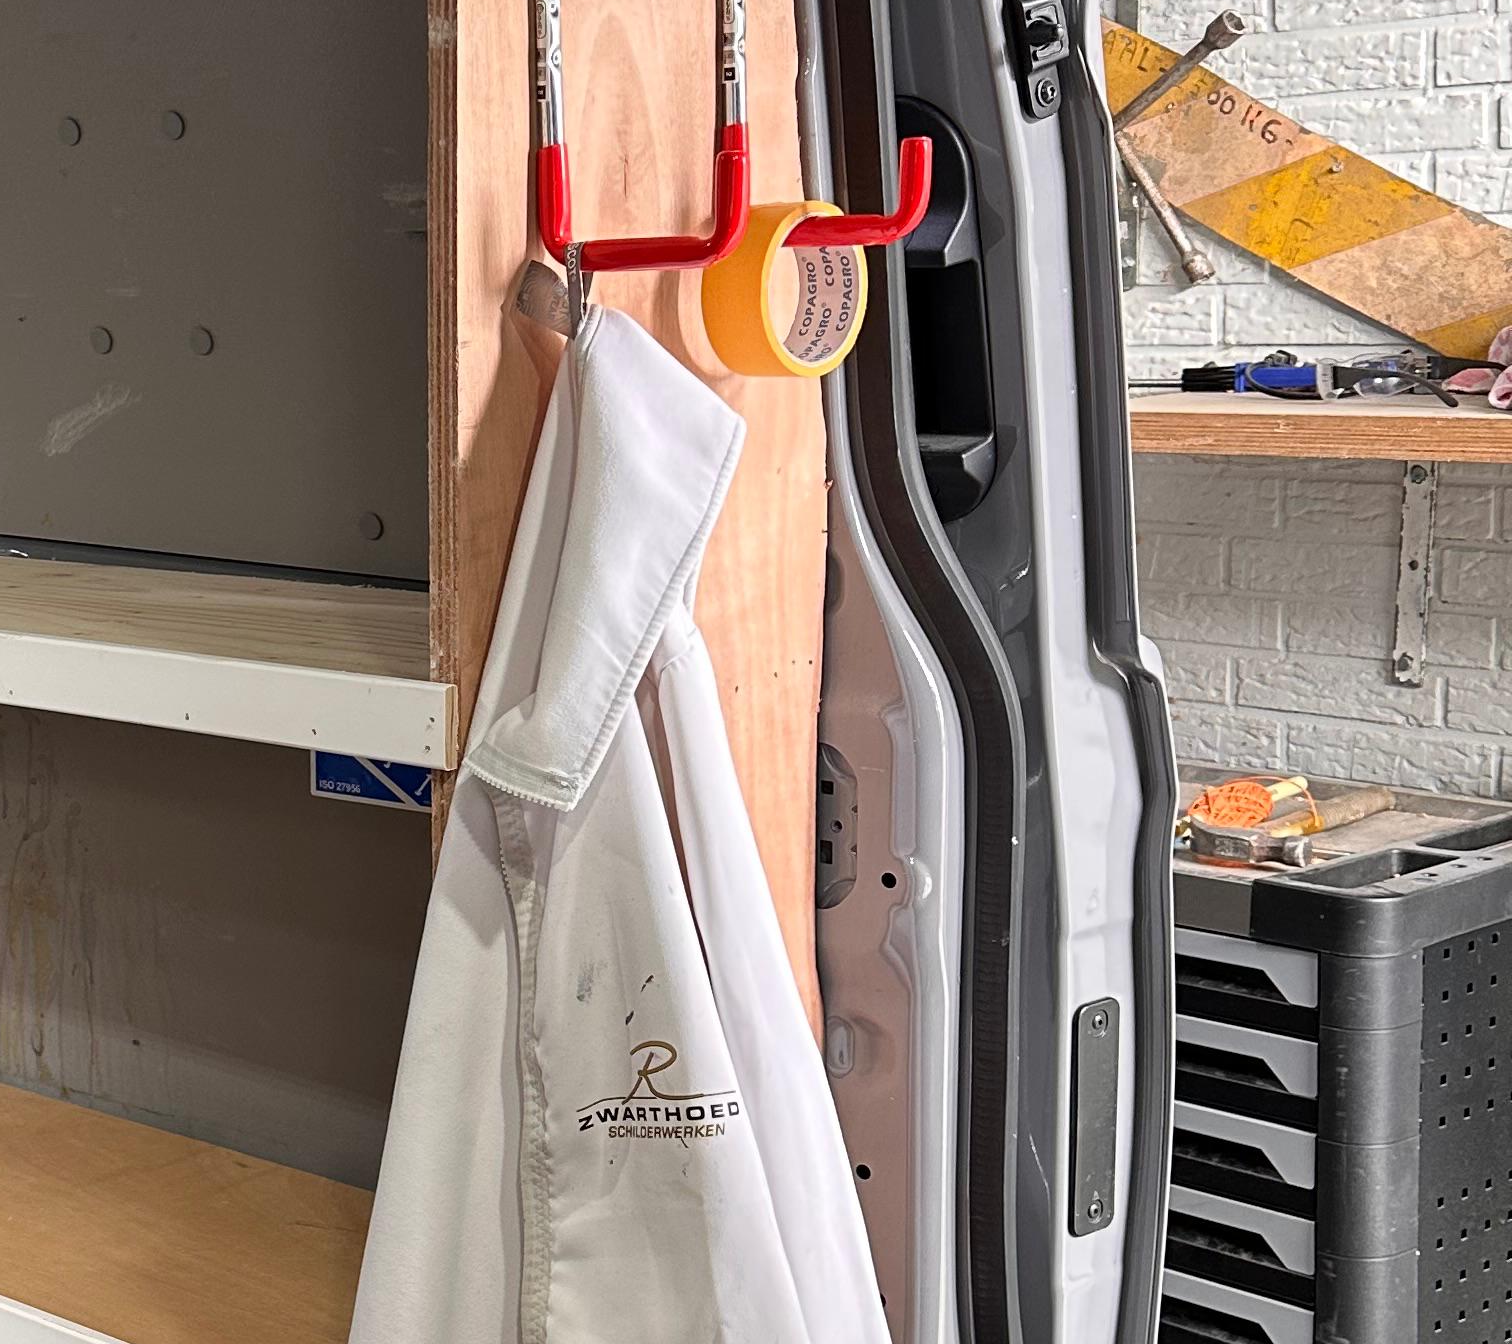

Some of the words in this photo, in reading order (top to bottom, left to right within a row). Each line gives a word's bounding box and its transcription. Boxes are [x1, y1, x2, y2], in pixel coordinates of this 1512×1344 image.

[319, 779, 334, 789] ISO
[578, 1102, 740, 1132] ZWARTHOED
[608, 1123, 726, 1139] SCHILDERWERKEN
